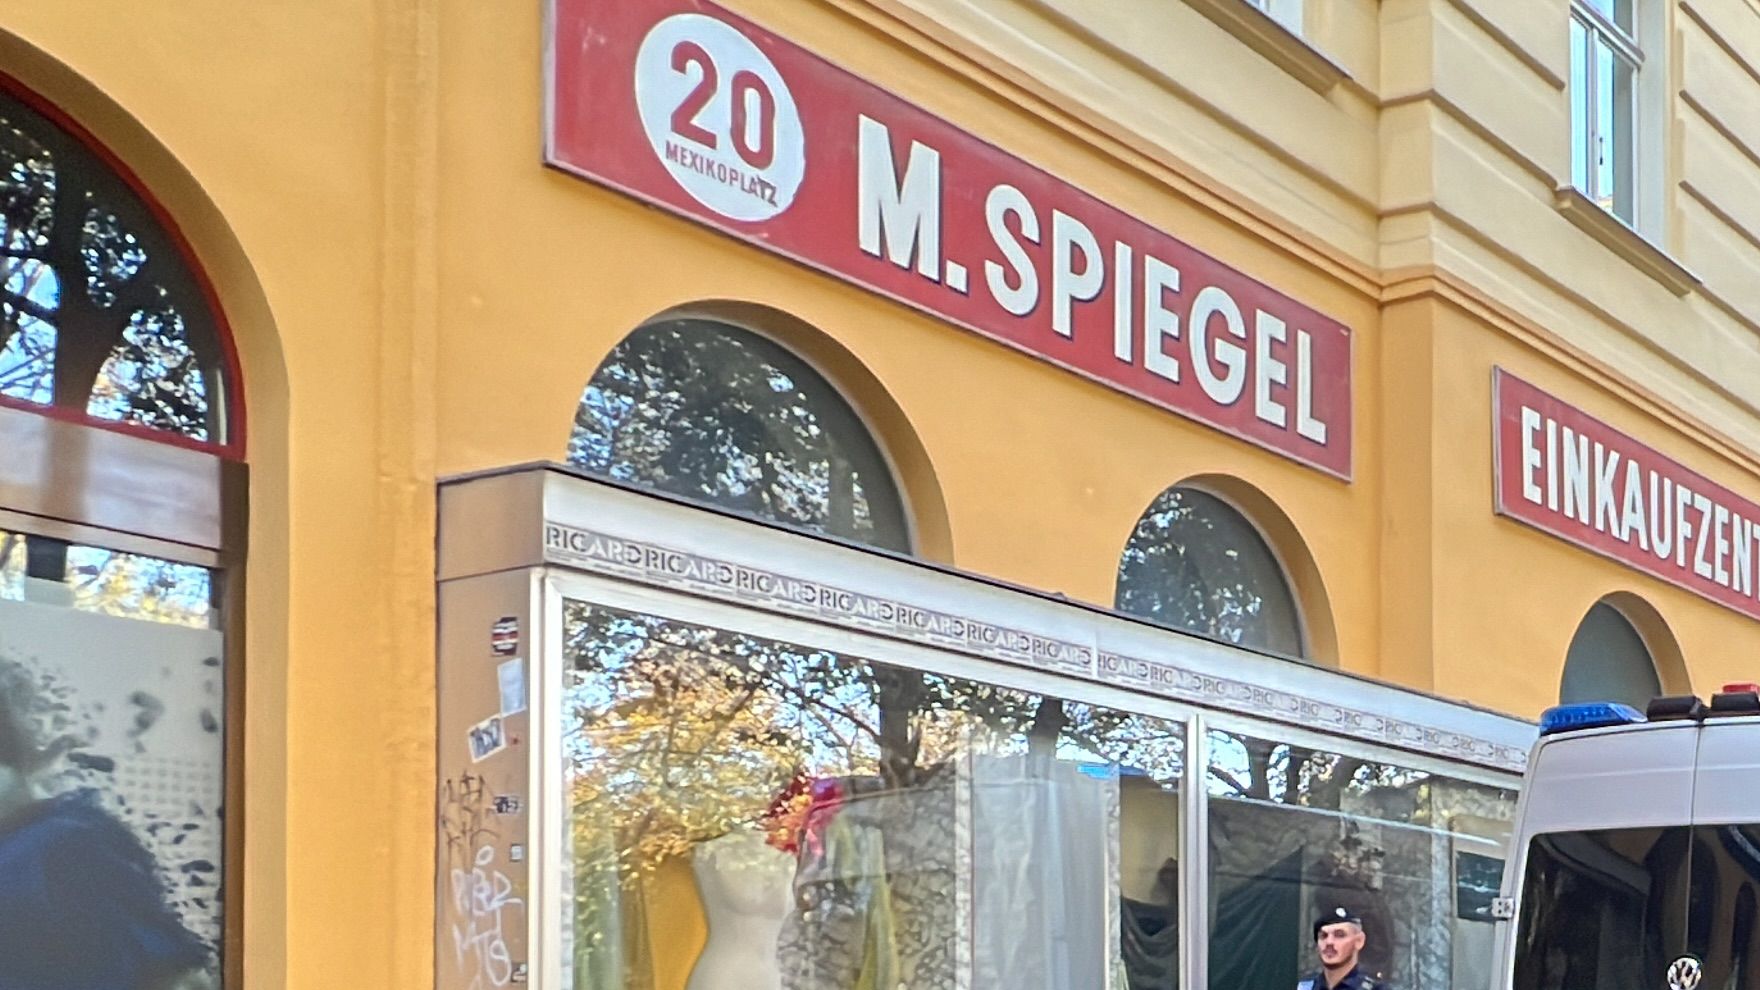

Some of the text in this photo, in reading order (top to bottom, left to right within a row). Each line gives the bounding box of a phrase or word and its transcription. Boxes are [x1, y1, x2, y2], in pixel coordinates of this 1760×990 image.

[670, 39, 776, 171] 20
[664, 139, 779, 208] MEXIKOPLATZ
[984, 183, 1328, 446] SPIEGEL
[546, 526, 642, 565] RICARD
[645, 549, 734, 585] RICARD
[736, 570, 817, 604] RICARD
